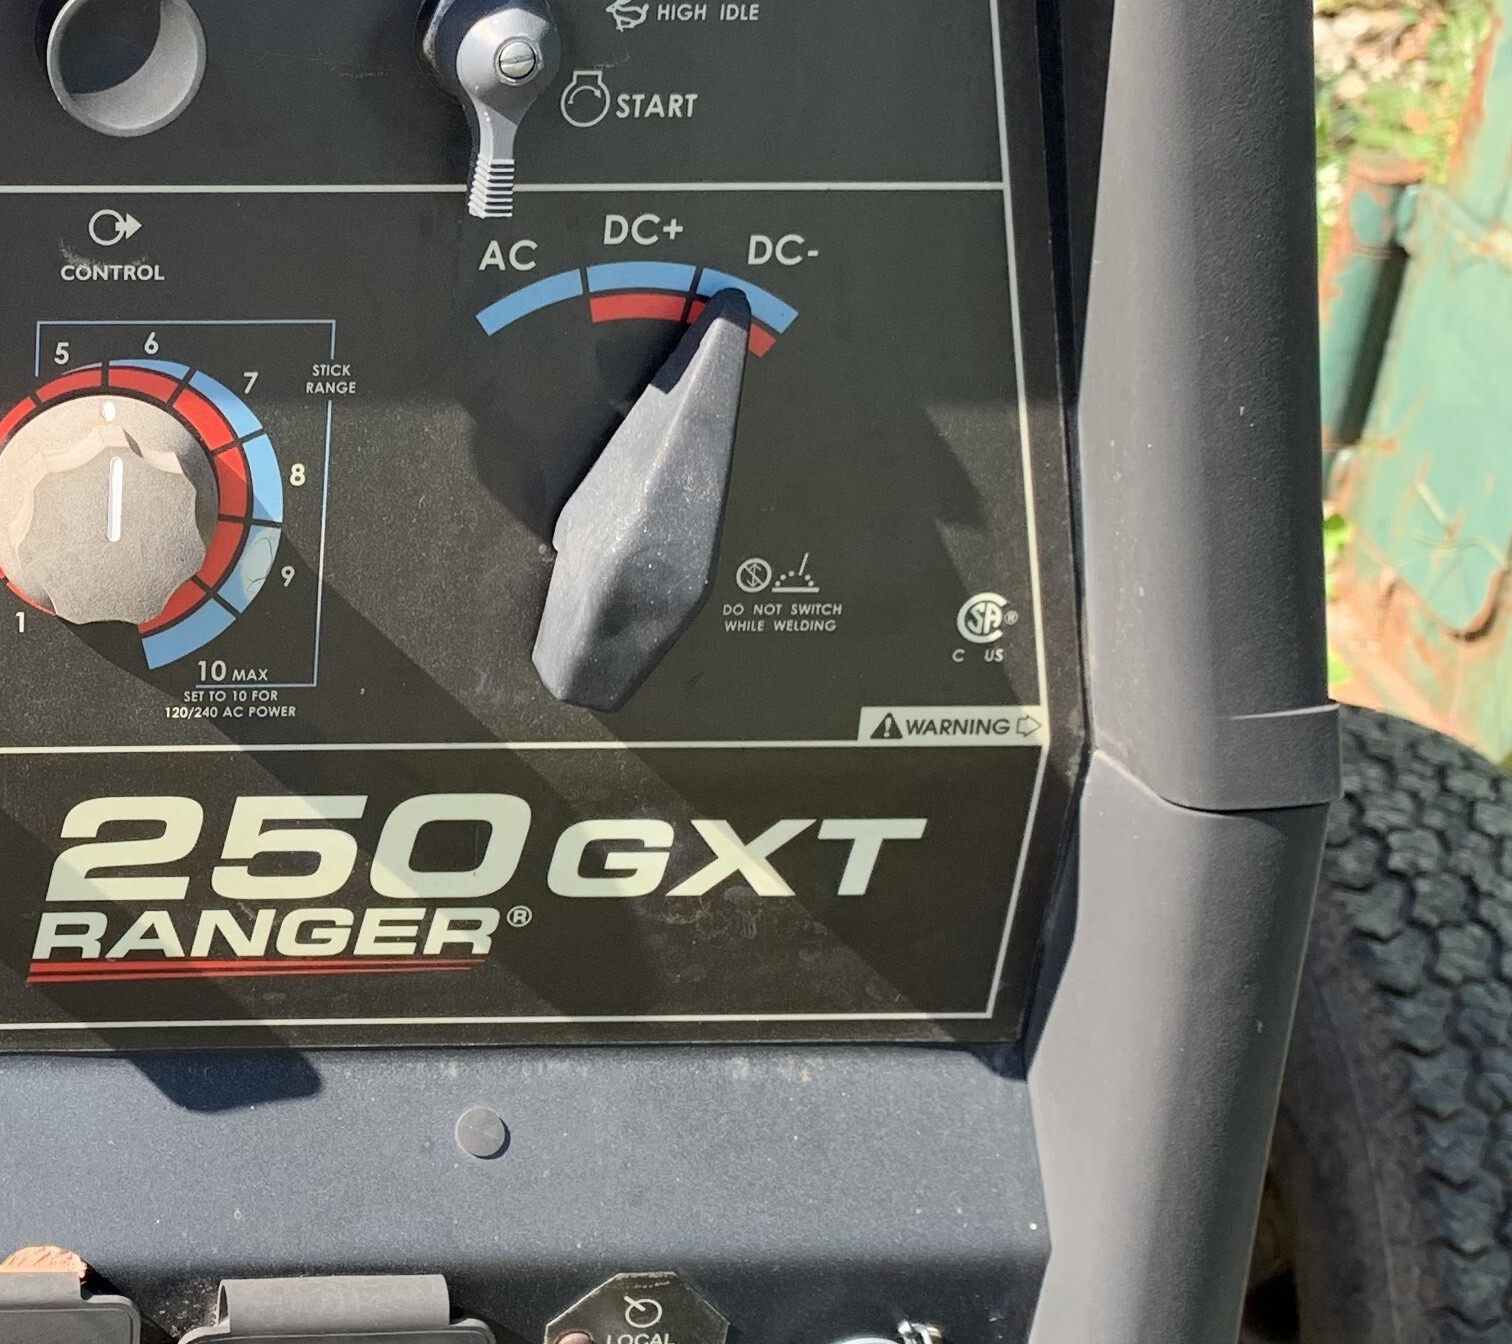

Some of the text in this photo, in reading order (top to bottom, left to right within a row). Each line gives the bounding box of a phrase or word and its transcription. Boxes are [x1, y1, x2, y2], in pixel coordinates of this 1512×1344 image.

[657, 3, 760, 22] HIGH IDLE
[615, 93, 698, 119] START
[478, 213, 819, 271] AC DC+ DC-
[60, 264, 166, 282] CONTROL
[54, 342, 70, 365] 5
[144, 332, 159, 355] 6
[312, 364, 351, 378] STICK
[243, 371, 259, 394] 7
[306, 381, 357, 395] RANGE
[290, 464, 306, 487] 8
[281, 566, 296, 587] 9
[722, 603, 843, 616] DO NOT SWITCH
[15, 611, 26, 634] 1
[724, 620, 837, 632] WHILE WELDING
[984, 648, 1004, 662] US
[197, 660, 268, 682] 10 MAX
[183, 690, 279, 703] SET TO 10 FOR
[165, 706, 297, 721] 120/240 AC POWER
[905, 719, 1011, 736] WARNING
[45, 792, 929, 902] 250 GXT
